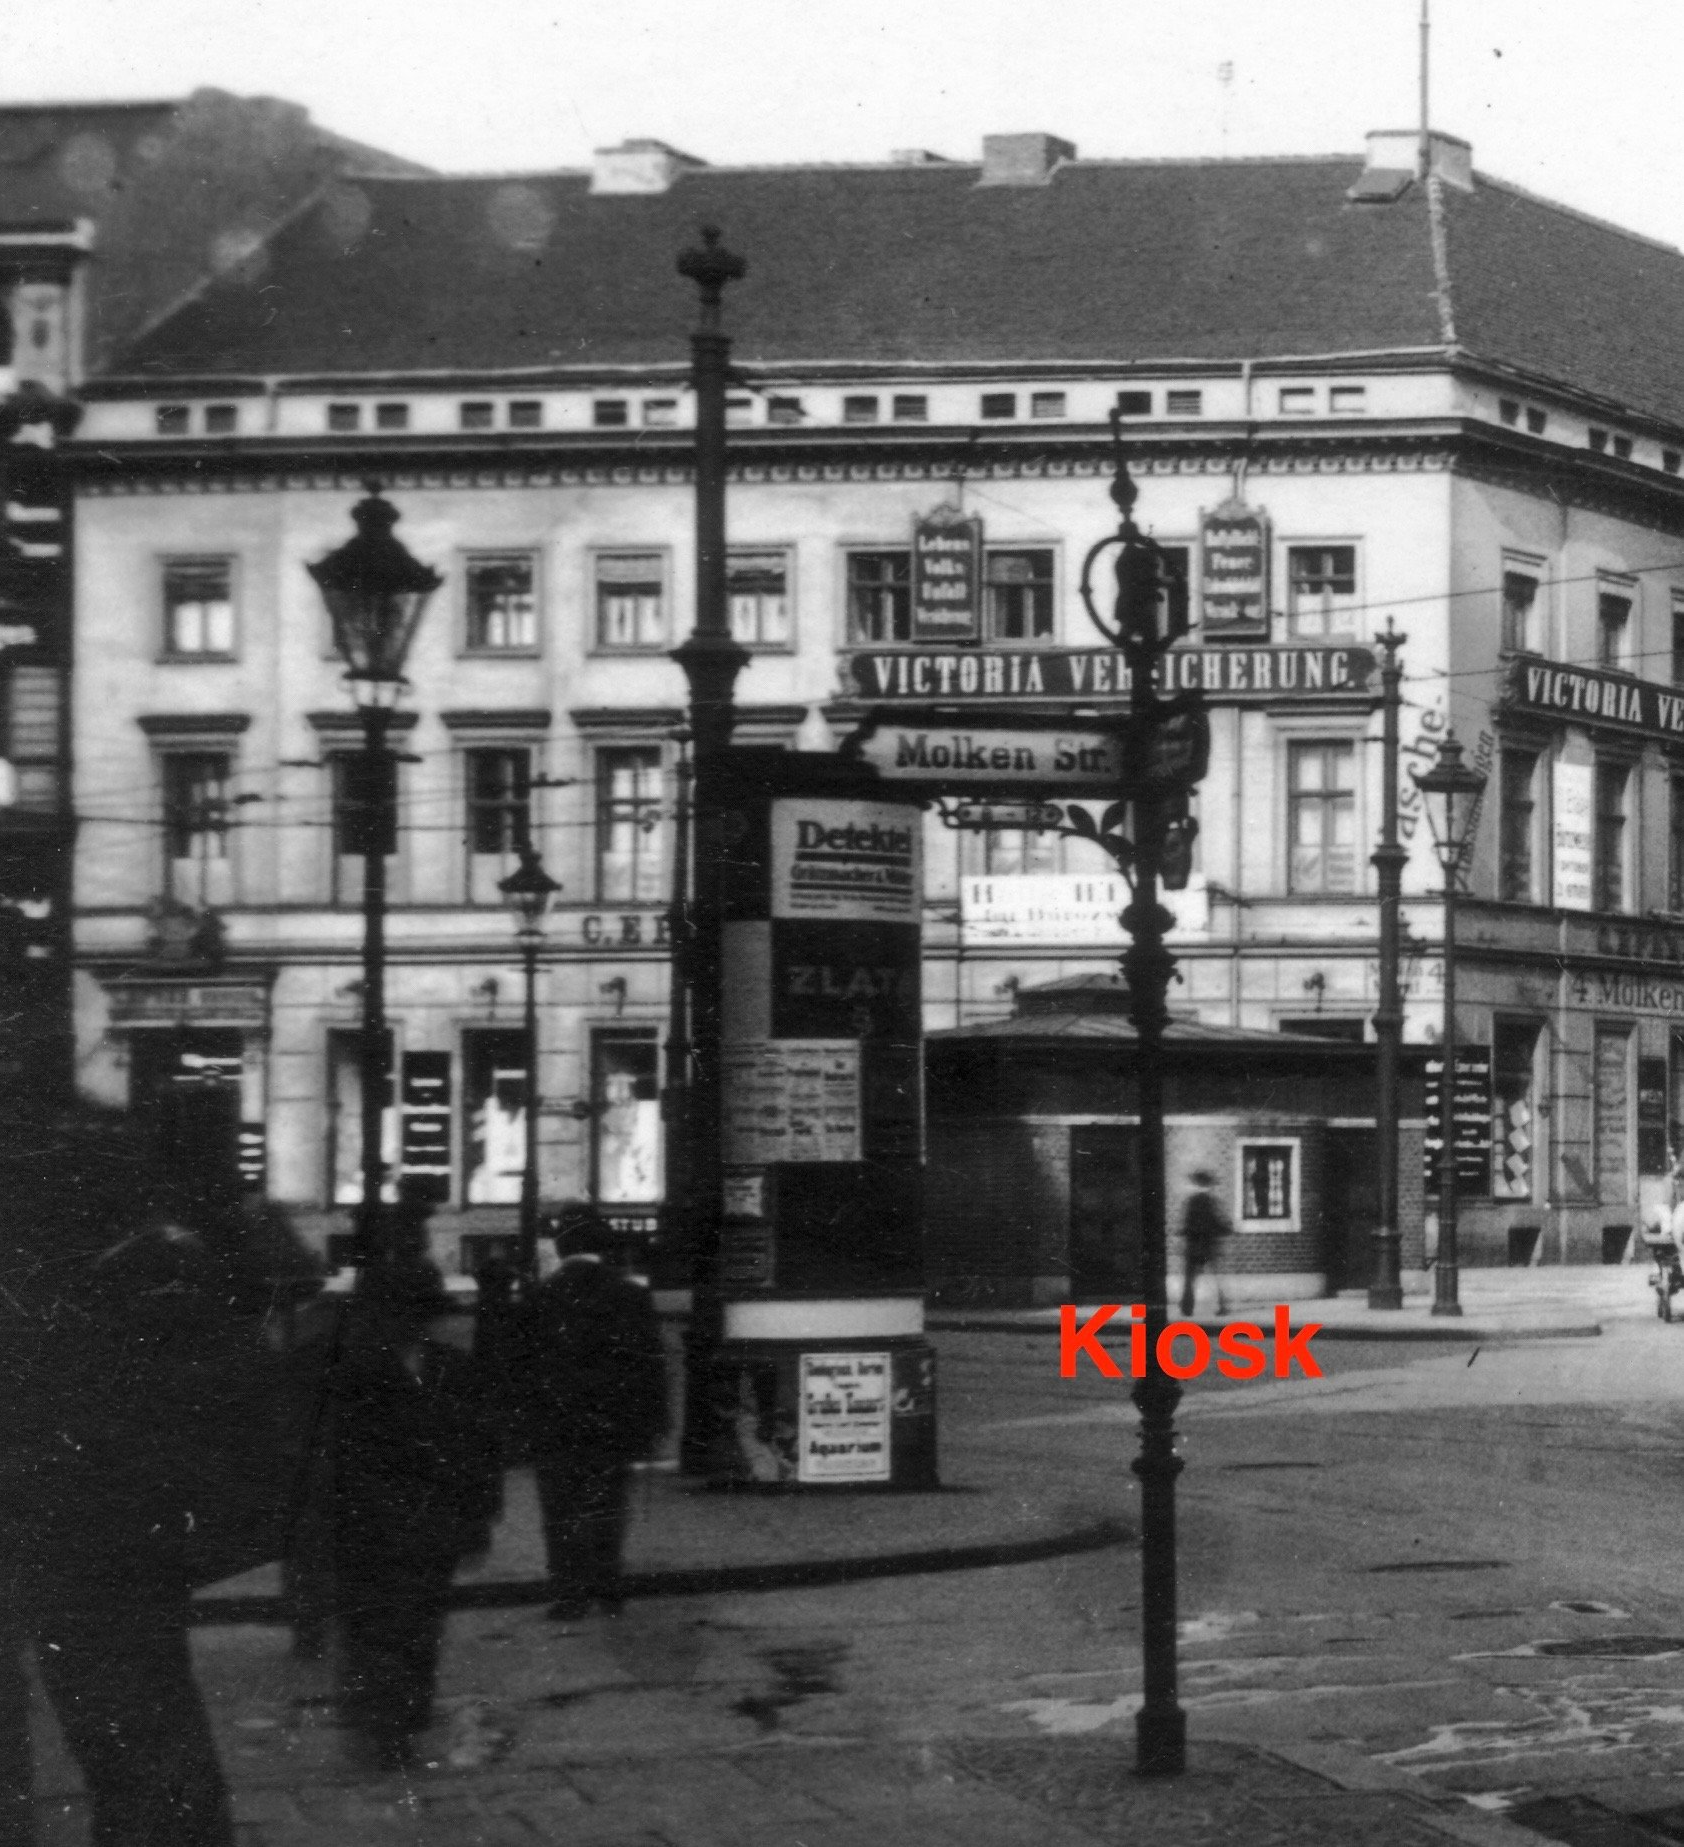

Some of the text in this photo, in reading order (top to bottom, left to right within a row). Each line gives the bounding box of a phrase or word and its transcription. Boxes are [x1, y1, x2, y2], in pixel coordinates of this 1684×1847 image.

[873, 655, 1045, 694] VICTORIA
[1528, 666, 1643, 723] VICTORIA
[895, 733, 1037, 772] Molken
[1054, 738, 1113, 773] Str.
